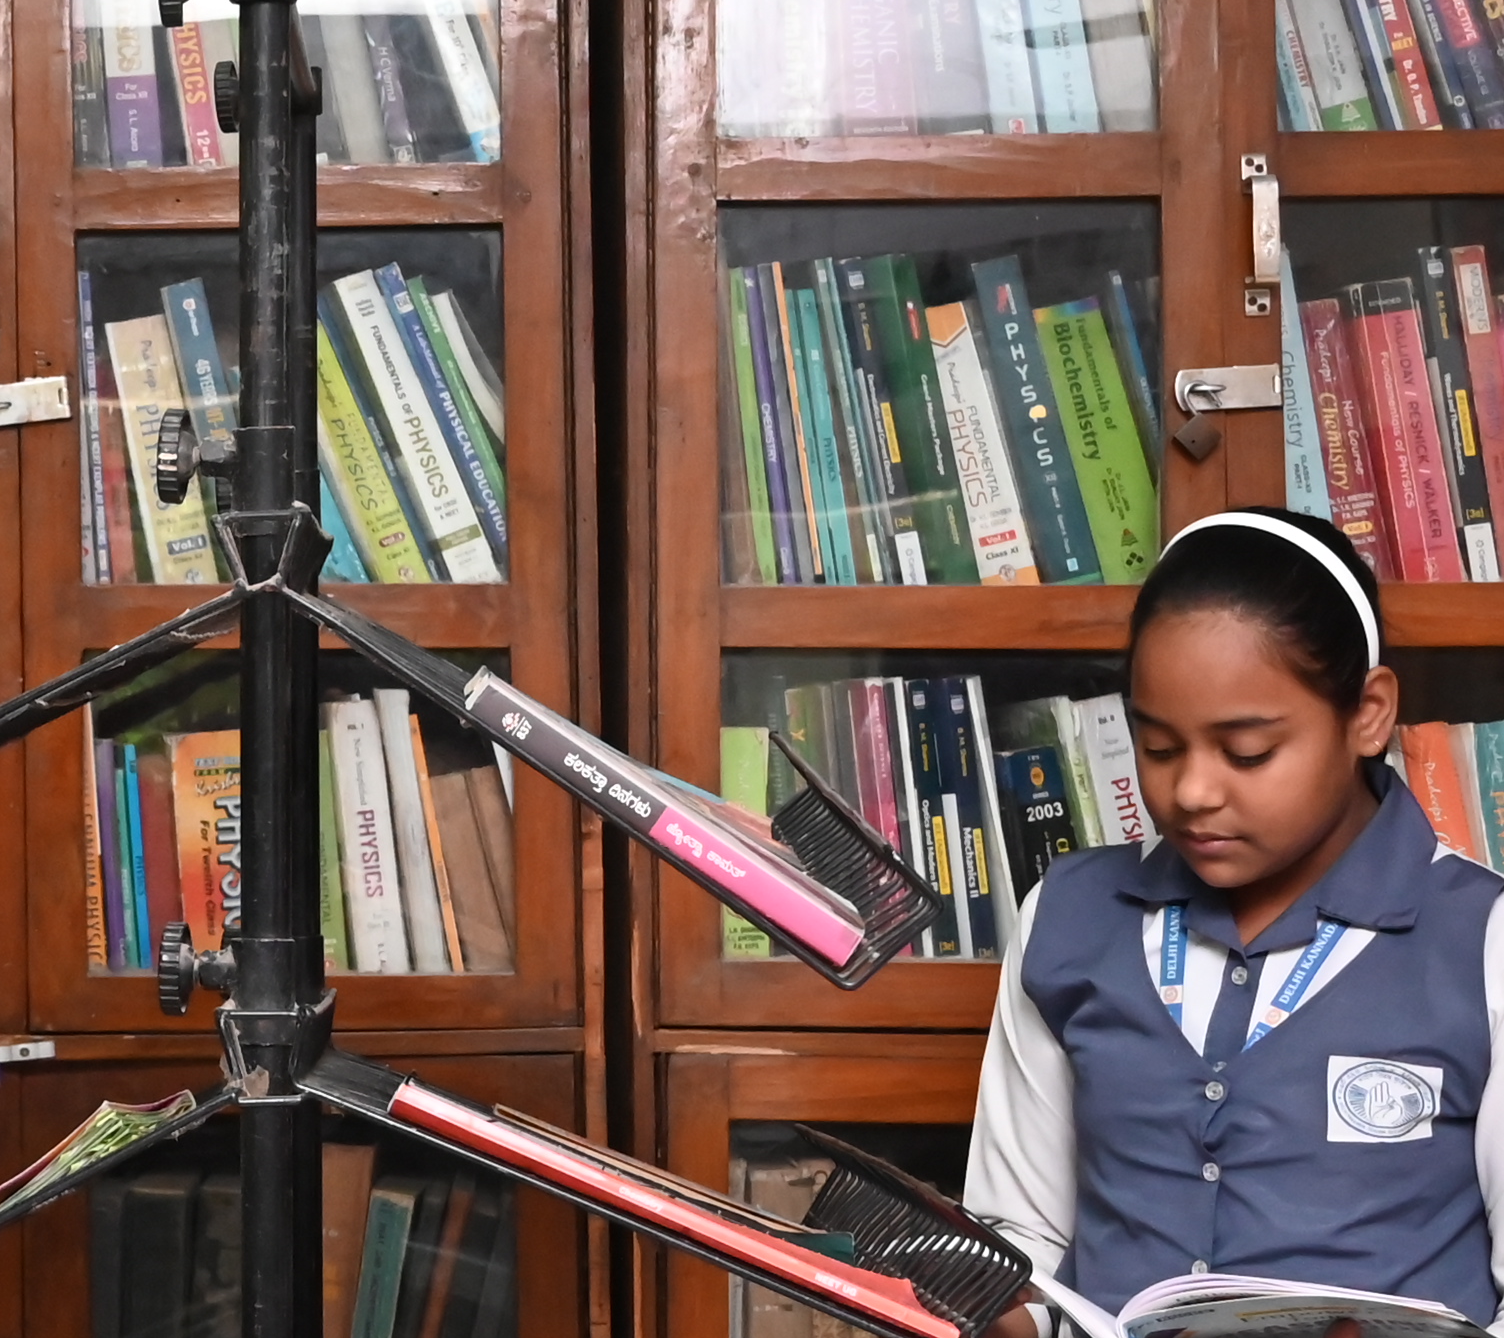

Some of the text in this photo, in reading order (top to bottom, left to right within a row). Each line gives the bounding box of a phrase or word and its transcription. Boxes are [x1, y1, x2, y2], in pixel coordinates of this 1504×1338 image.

[380, 68, 397, 103] Verma
[1285, 30, 1310, 88] CHEMISTRY
[195, 358, 218, 406] 46 YEARS
[370, 324, 449, 499] FUNDAMENTALS OF PHYSICS
[1053, 322, 1104, 462] Biochemistry
[1075, 317, 1118, 431] Fundamentals of
[1281, 350, 1307, 449] Chemistry
[330, 417, 379, 512] PHYSICS
[437, 391, 476, 459] PHYSICAL
[761, 403, 777, 463] CHEMISTRY
[823, 436, 838, 482] PHYSICS
[846, 425, 865, 479] PHYSICS
[947, 409, 988, 508] PHYSICS
[966, 404, 1002, 503] FUNDAMENTAL
[1317, 392, 1351, 490] Chemistry
[1342, 399, 1366, 475] New Course
[1380, 351, 1415, 509] Fundamentals of PHYSICS
[1393, 315, 1443, 539] HALLIDAY RESNICK WALKER
[356, 808, 385, 899] PHYSICS
[921, 799, 938, 880] Optics Modern
[1025, 804, 1065, 822] 2003
[199, 819, 217, 936] For Twelfth Class
[961, 827, 978, 885] Mechanics
[1166, 942, 1178, 980] DELHI
[1277, 967, 1308, 1006] DELHI
